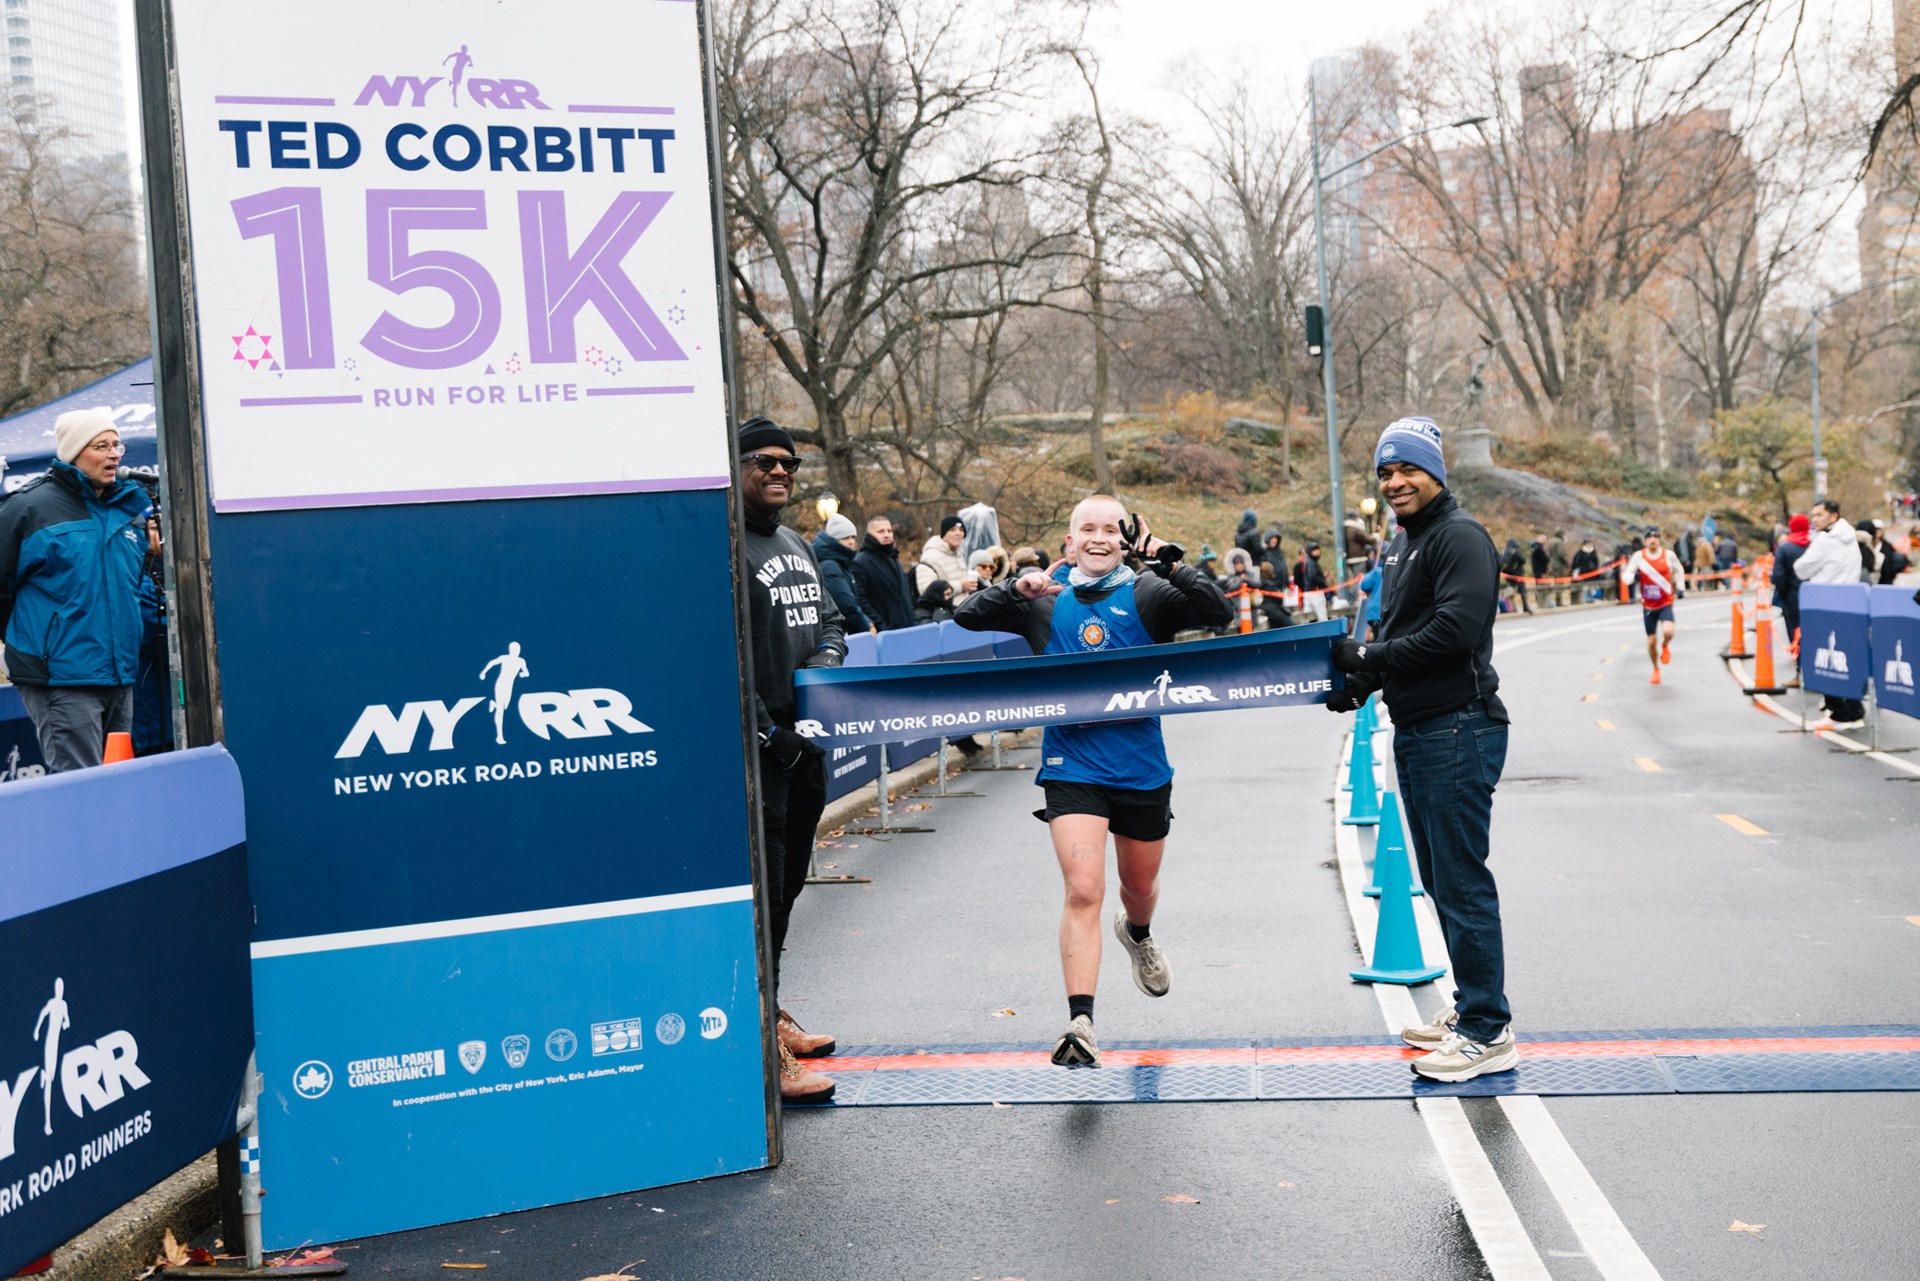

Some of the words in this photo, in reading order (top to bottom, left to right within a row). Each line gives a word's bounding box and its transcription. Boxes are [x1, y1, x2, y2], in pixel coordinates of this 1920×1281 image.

[218, 119, 362, 170] TED
[385, 122, 676, 173] CORBITT
[230, 187, 690, 370] 15K
[374, 387, 436, 408] RUN
[448, 384, 506, 405] FOR
[518, 383, 579, 403] LIFE
[755, 555, 786, 588] NEW
[782, 554, 819, 584] YORK
[785, 606, 819, 628] CLUB
[1228, 686, 1262, 701] RUN
[1264, 683, 1297, 697] FOR
[1299, 679, 1332, 693] LIFE
[834, 719, 875, 736] NEW
[880, 716, 928, 732] YORK
[931, 711, 981, 728] ROAD
[987, 703, 1067, 722] RUNNERS
[334, 773, 394, 796] NEW
[400, 767, 468, 789] YORK
[475, 760, 542, 782] ROAD
[550, 750, 658, 776] RUNNERS
[700, 1016, 723, 1033] MTA
[594, 1029, 640, 1053] DOT
[347, 1055, 401, 1075] CENTRAL
[401, 1051, 434, 1069] PARK
[348, 1063, 434, 1088] CONSERVANCY
[393, 1099, 402, 1107] In
[403, 1091, 457, 1106] cooperation
[458, 1087, 477, 1097] with
[479, 1086, 493, 1094] the
[495, 1083, 513, 1092] City
[514, 1081, 524, 1089] of
[526, 1078, 545, 1088] New
[546, 1075, 567, 1085] York,
[568, 1072, 585, 1081] Eric
[587, 1068, 617, 1078] Adams,
[618, 1064, 644, 1074] Mayor
[28, 1153, 76, 1200] ROAD
[81, 1110, 152, 1170] RUNNERS
